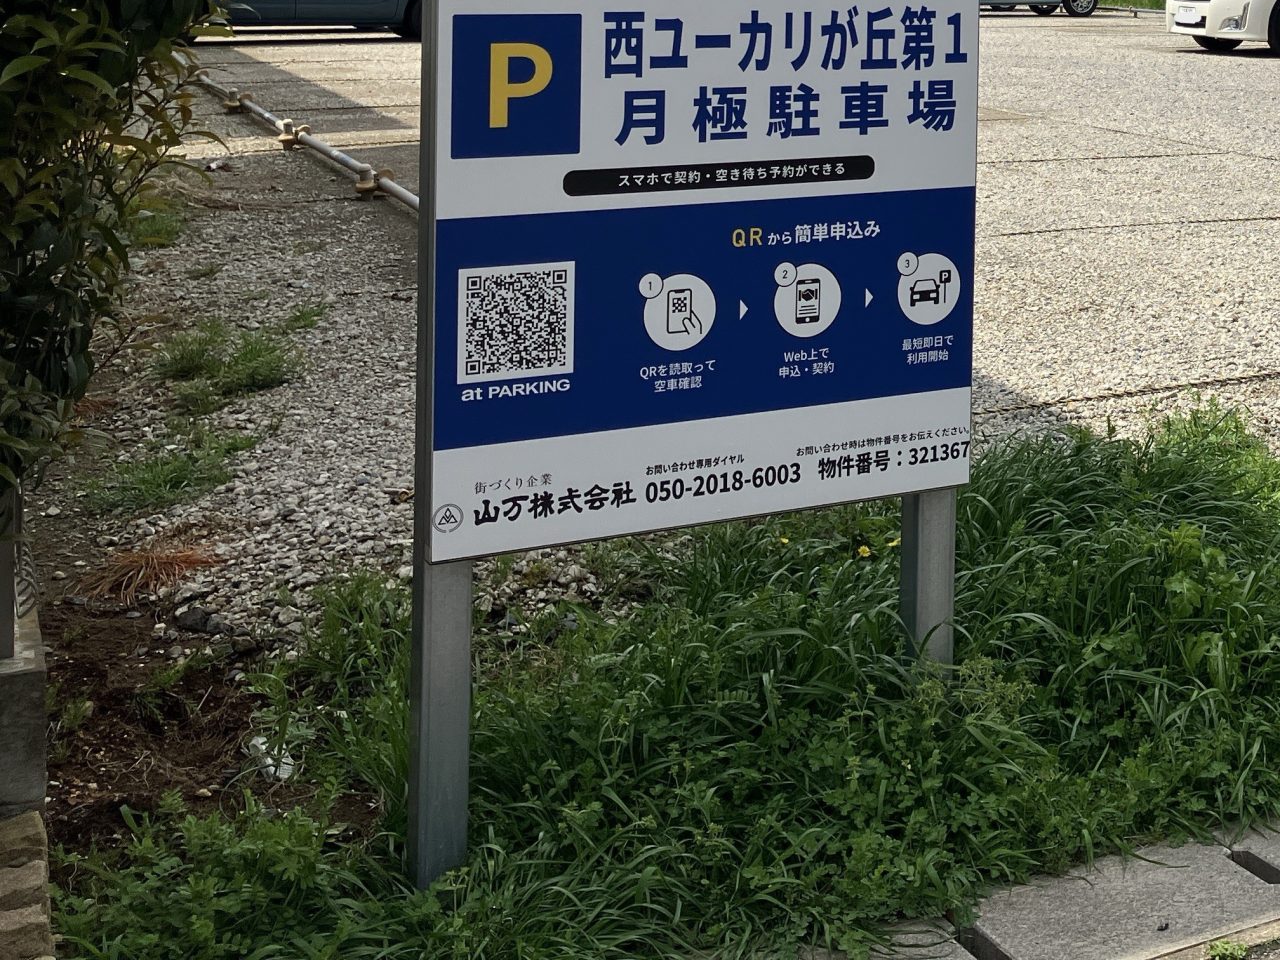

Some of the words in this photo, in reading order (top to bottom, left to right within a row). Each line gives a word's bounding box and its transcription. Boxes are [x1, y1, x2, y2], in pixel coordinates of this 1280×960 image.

[603, 5, 968, 79] 西ユーカリが丘第1
[489, 42, 553, 129] P
[614, 80, 957, 146] 月極駐車場
[618, 163, 845, 187] スマホで契約・空き待ち予約ができる
[901, 335, 954, 351] 最短即日で
[783, 347, 830, 363] Web上で
[906, 349, 949, 365] 利用開始
[639, 359, 716, 380] QRを読取って
[778, 361, 835, 378] 申込・契約
[461, 387, 483, 402] at
[488, 379, 571, 399] PARKING
[654, 375, 703, 393] 空車確認
[796, 426, 970, 457] お問い合わせ時は物件番号をお伝えください。
[645, 453, 745, 476] お問い合わせ専用ダイヤル
[474, 473, 553, 495] 街づくり企業
[645, 462, 801, 504] 050-2018-6003
[473, 481, 637, 526] 山万株式会社
